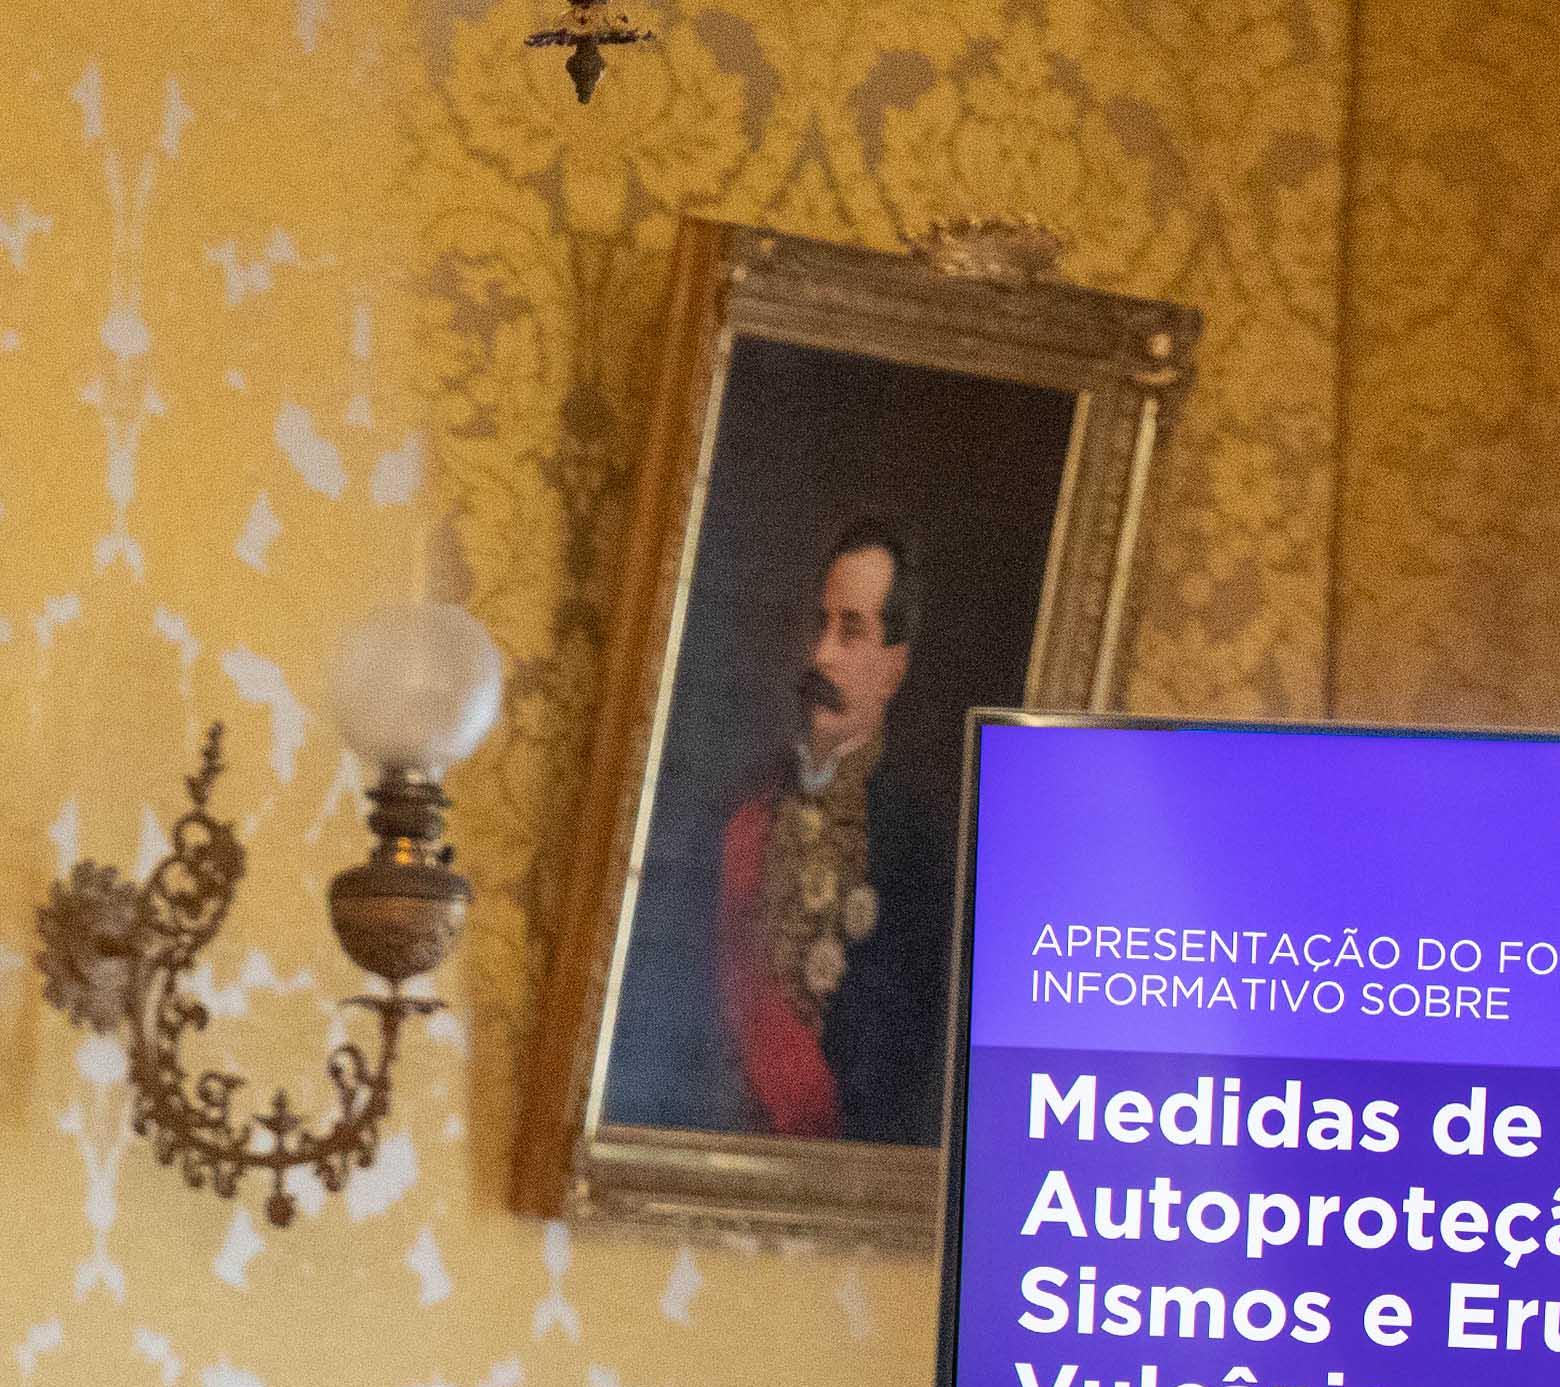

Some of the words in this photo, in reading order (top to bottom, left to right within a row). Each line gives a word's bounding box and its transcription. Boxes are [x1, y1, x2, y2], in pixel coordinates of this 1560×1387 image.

[1031, 922, 1401, 972] APRESENTAÇÃO
[1416, 939, 1483, 972] DO
[1031, 970, 1346, 1014] INFORMATIVO
[1360, 983, 1511, 1020] SOBRE
[1027, 1072, 1401, 1154] Medidas
[1432, 1087, 1543, 1158] de
[1017, 1266, 1332, 1346] Sismos
[1363, 1292, 1413, 1346] e
